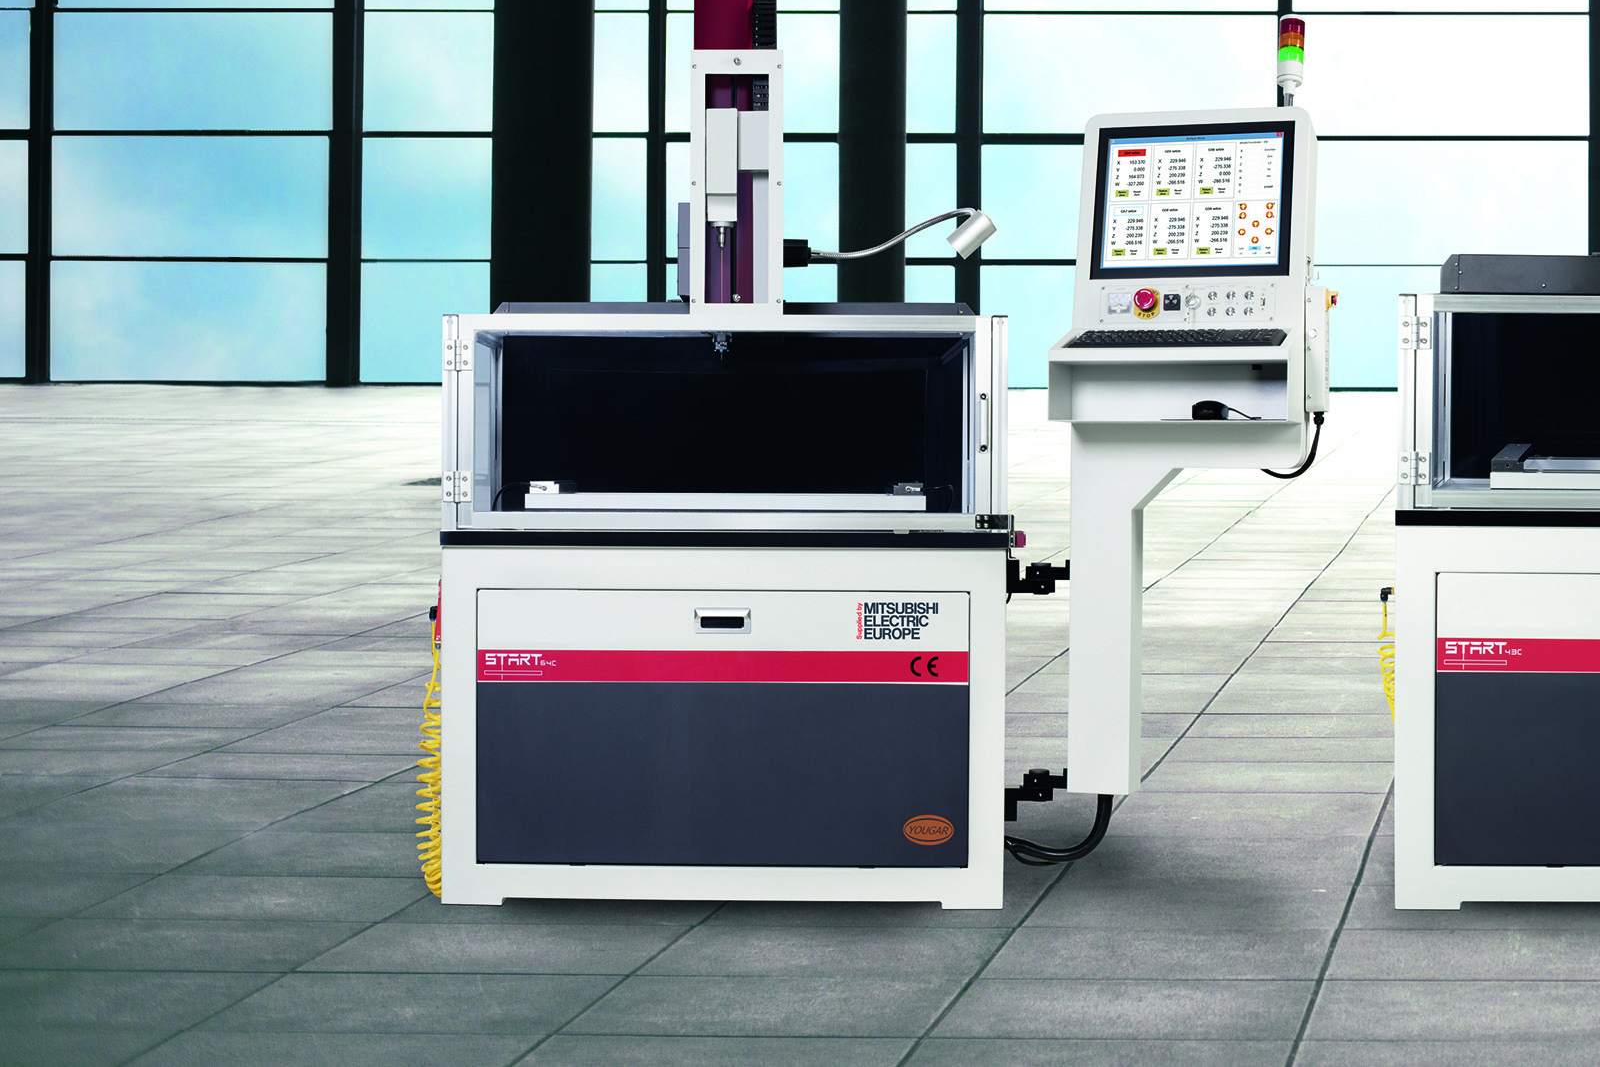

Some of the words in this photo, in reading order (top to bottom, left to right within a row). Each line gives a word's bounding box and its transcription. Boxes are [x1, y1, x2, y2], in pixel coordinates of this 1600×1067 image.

[856, 603, 863, 611] by
[864, 603, 939, 614] MITSUBISHI
[864, 615, 929, 627] ELECTRIC
[864, 628, 920, 639] EUROPE
[910, 656, 939, 677] CE
[909, 825, 949, 835] YOUGAR
